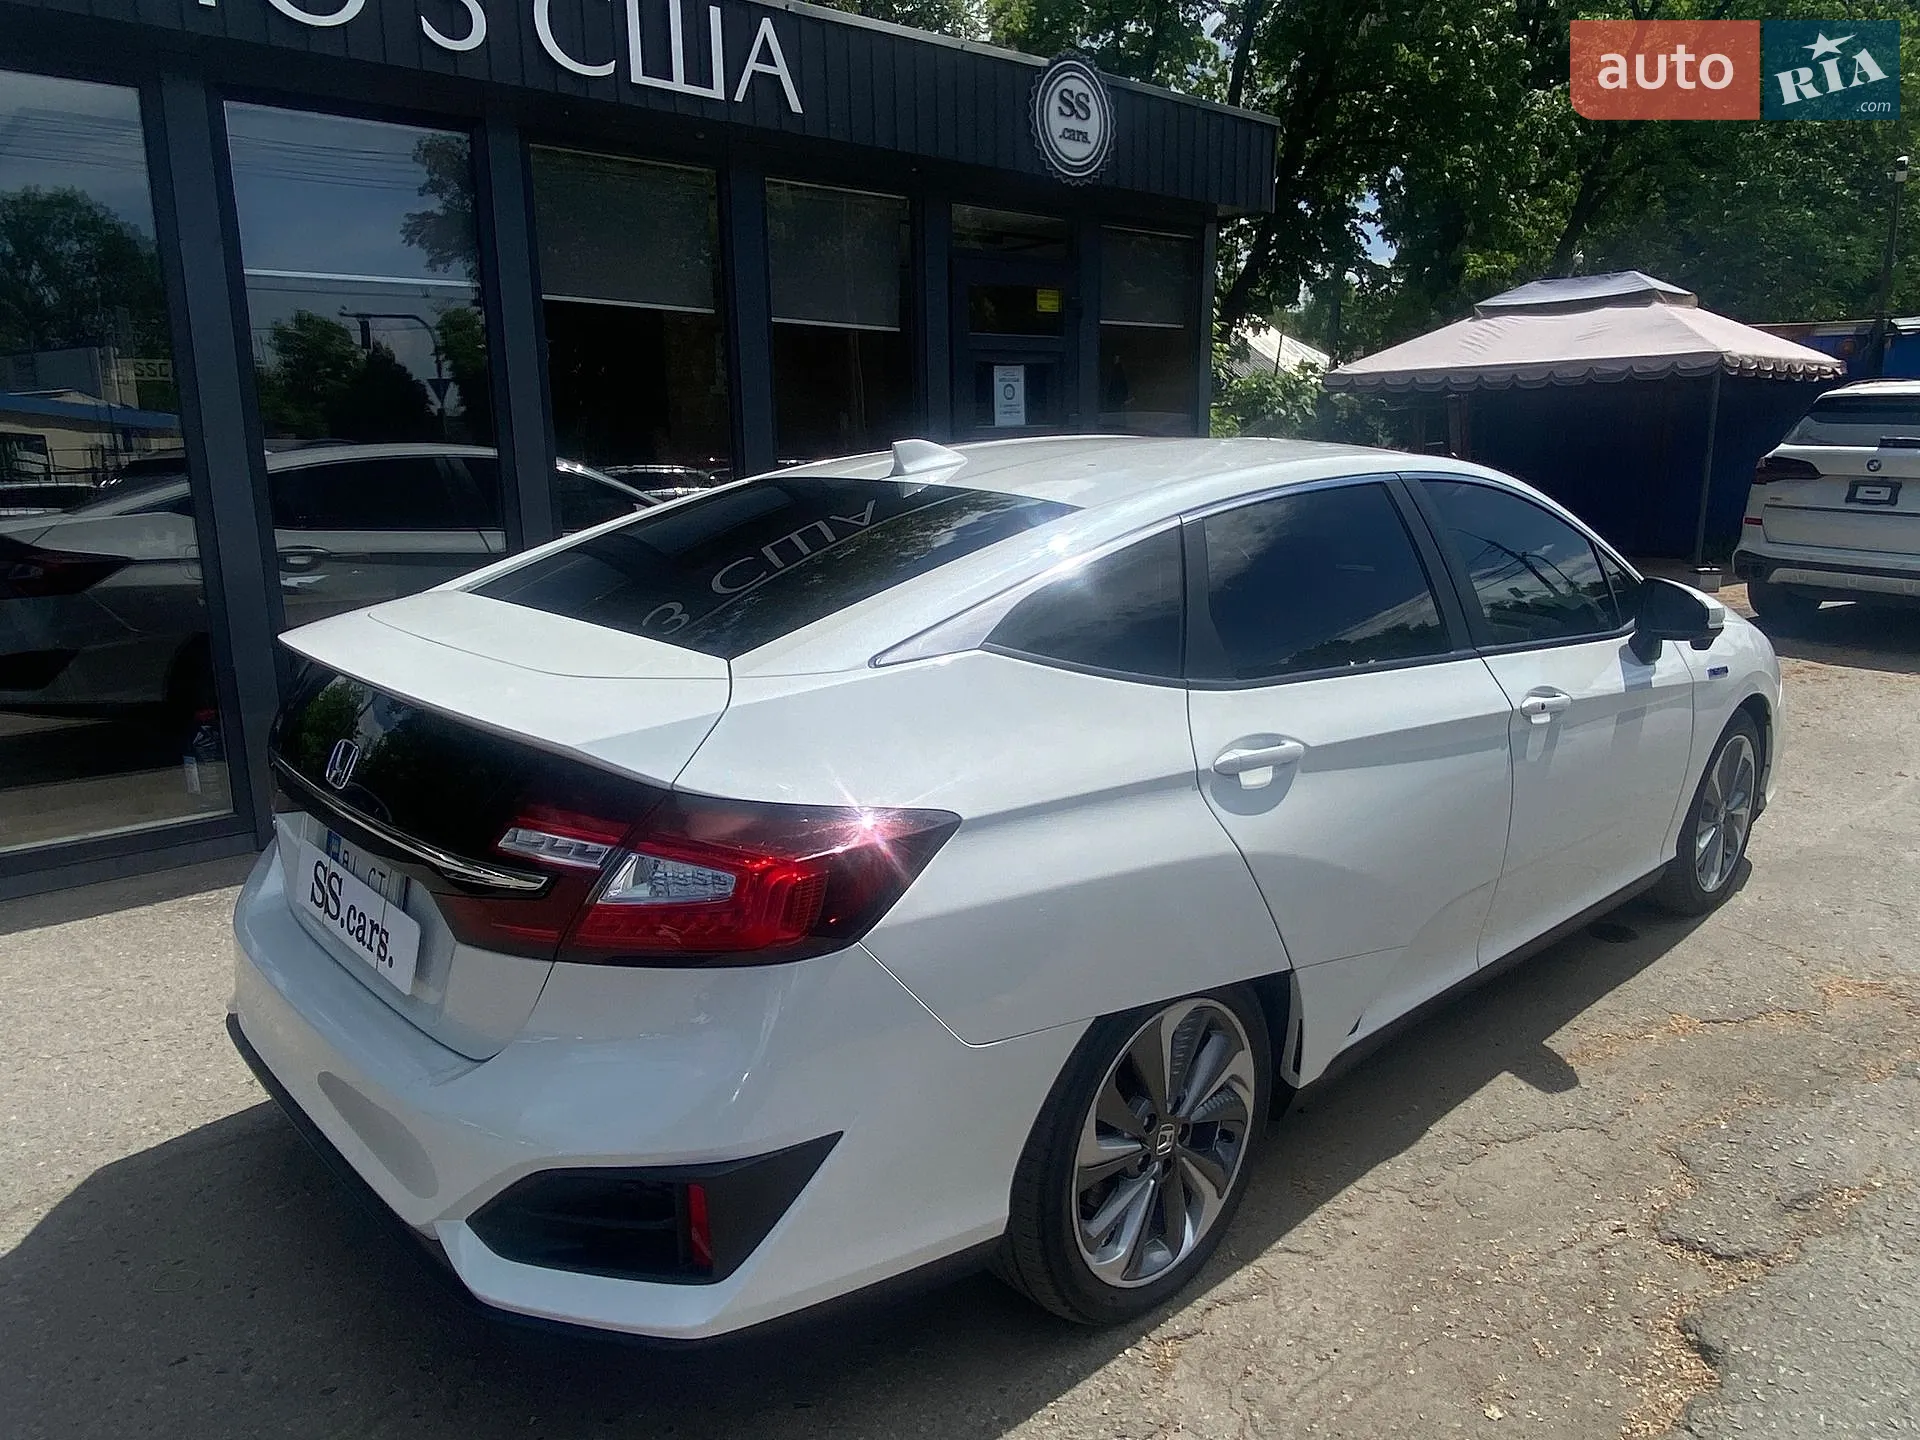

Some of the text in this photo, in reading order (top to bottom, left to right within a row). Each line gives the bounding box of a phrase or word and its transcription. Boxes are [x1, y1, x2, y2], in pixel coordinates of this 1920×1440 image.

[533, 0, 803, 114] США
[1058, 88, 1091, 120] SS
[310, 860, 394, 968] SS.cars.
